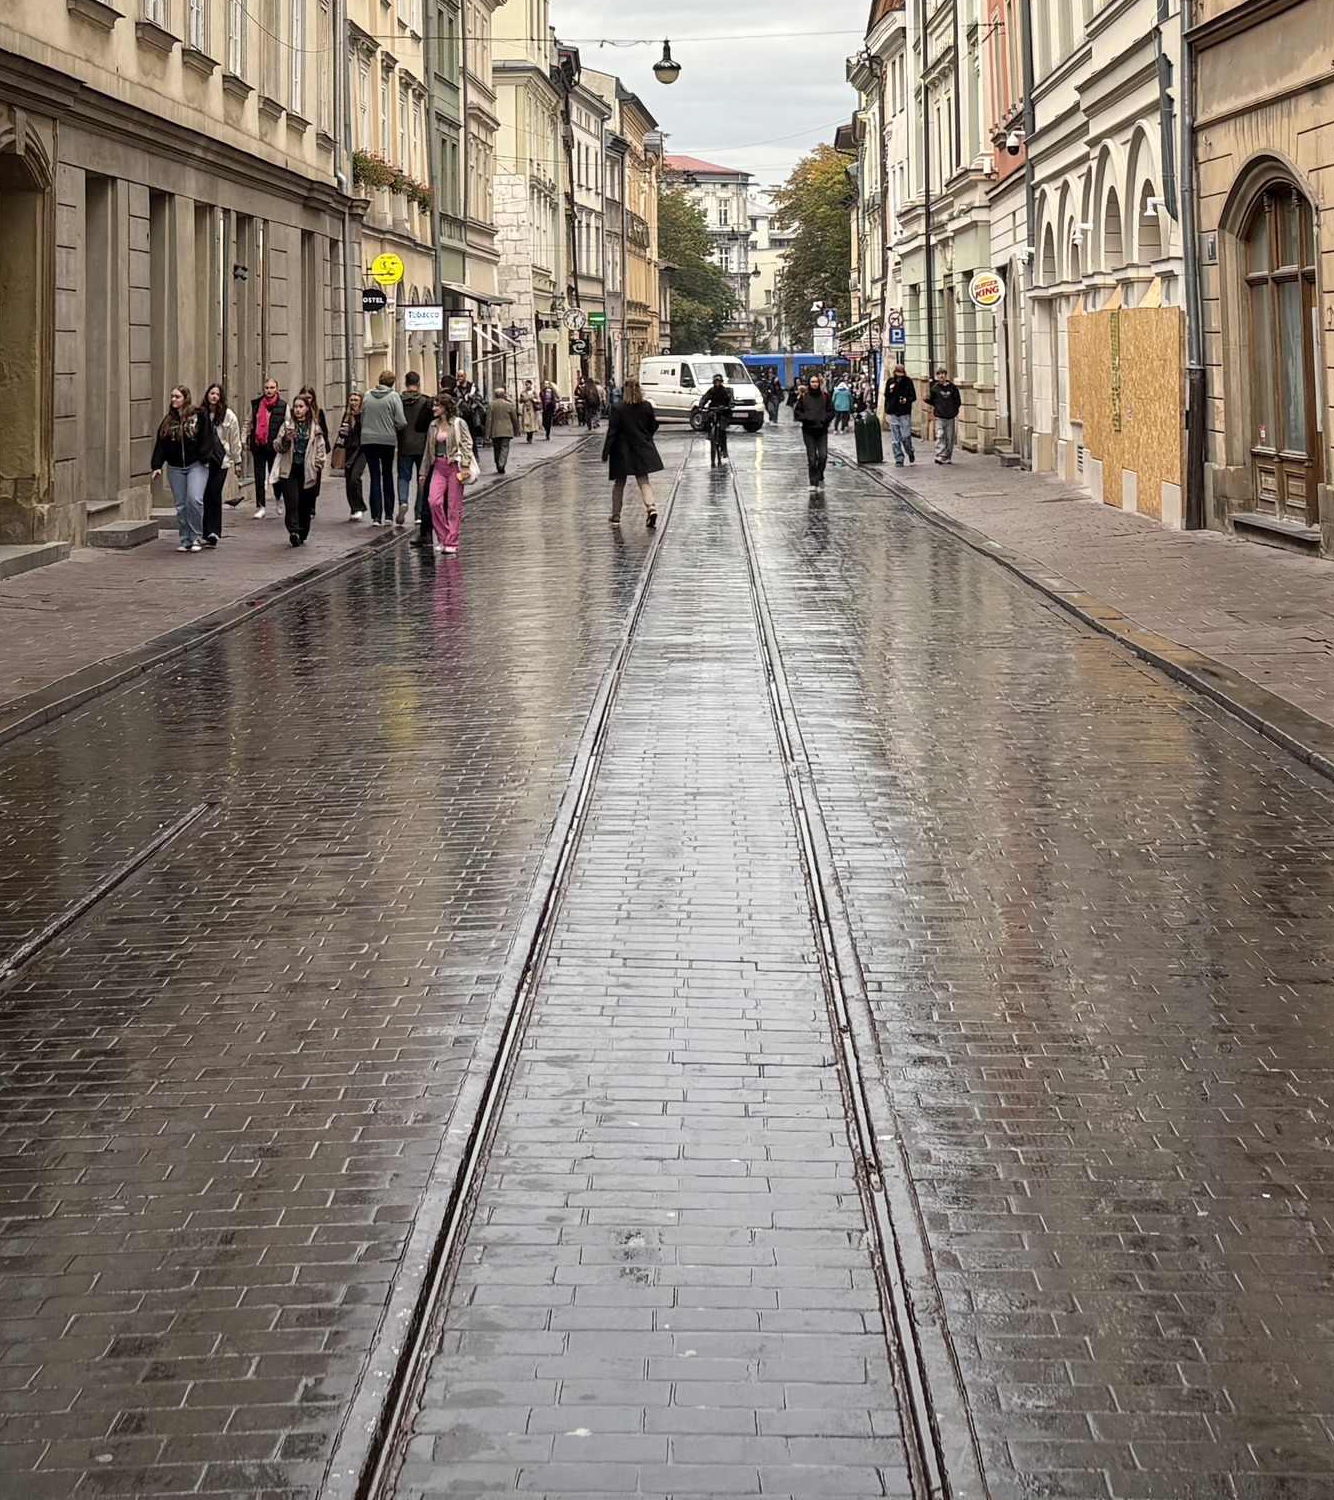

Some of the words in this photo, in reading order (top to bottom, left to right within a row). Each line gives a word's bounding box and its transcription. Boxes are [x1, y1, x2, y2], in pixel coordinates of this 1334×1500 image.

[974, 279, 998, 291] BURGER
[975, 285, 999, 300] KING
[408, 311, 440, 319] Tobacco
